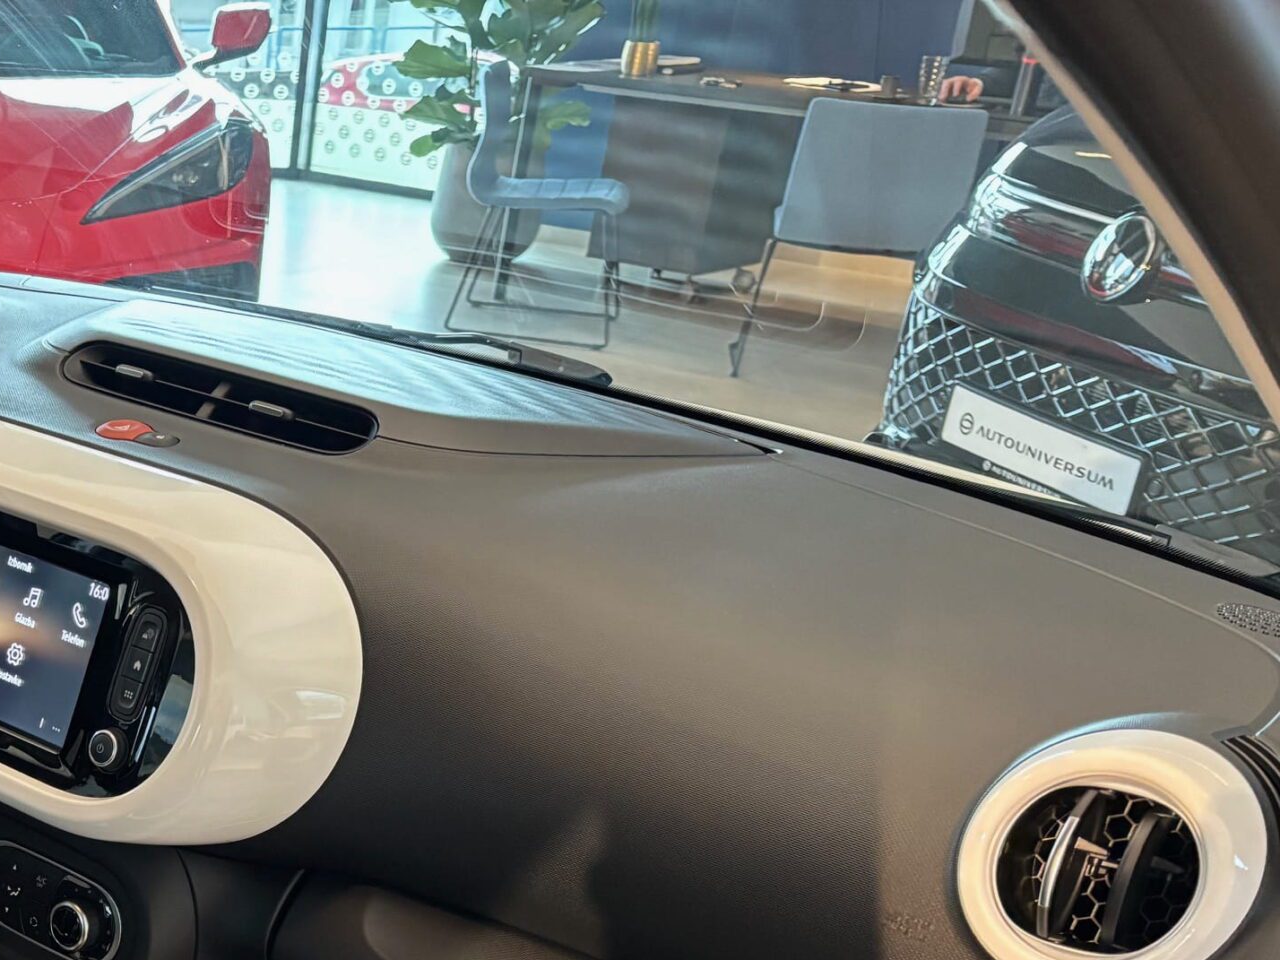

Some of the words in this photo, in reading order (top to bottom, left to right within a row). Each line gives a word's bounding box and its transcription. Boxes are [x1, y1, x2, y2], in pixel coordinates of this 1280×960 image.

[976, 426, 1114, 491] AUTOUNIVERSUM
[15, 612, 36, 628] Glazba
[61, 629, 86, 648] Telefon
